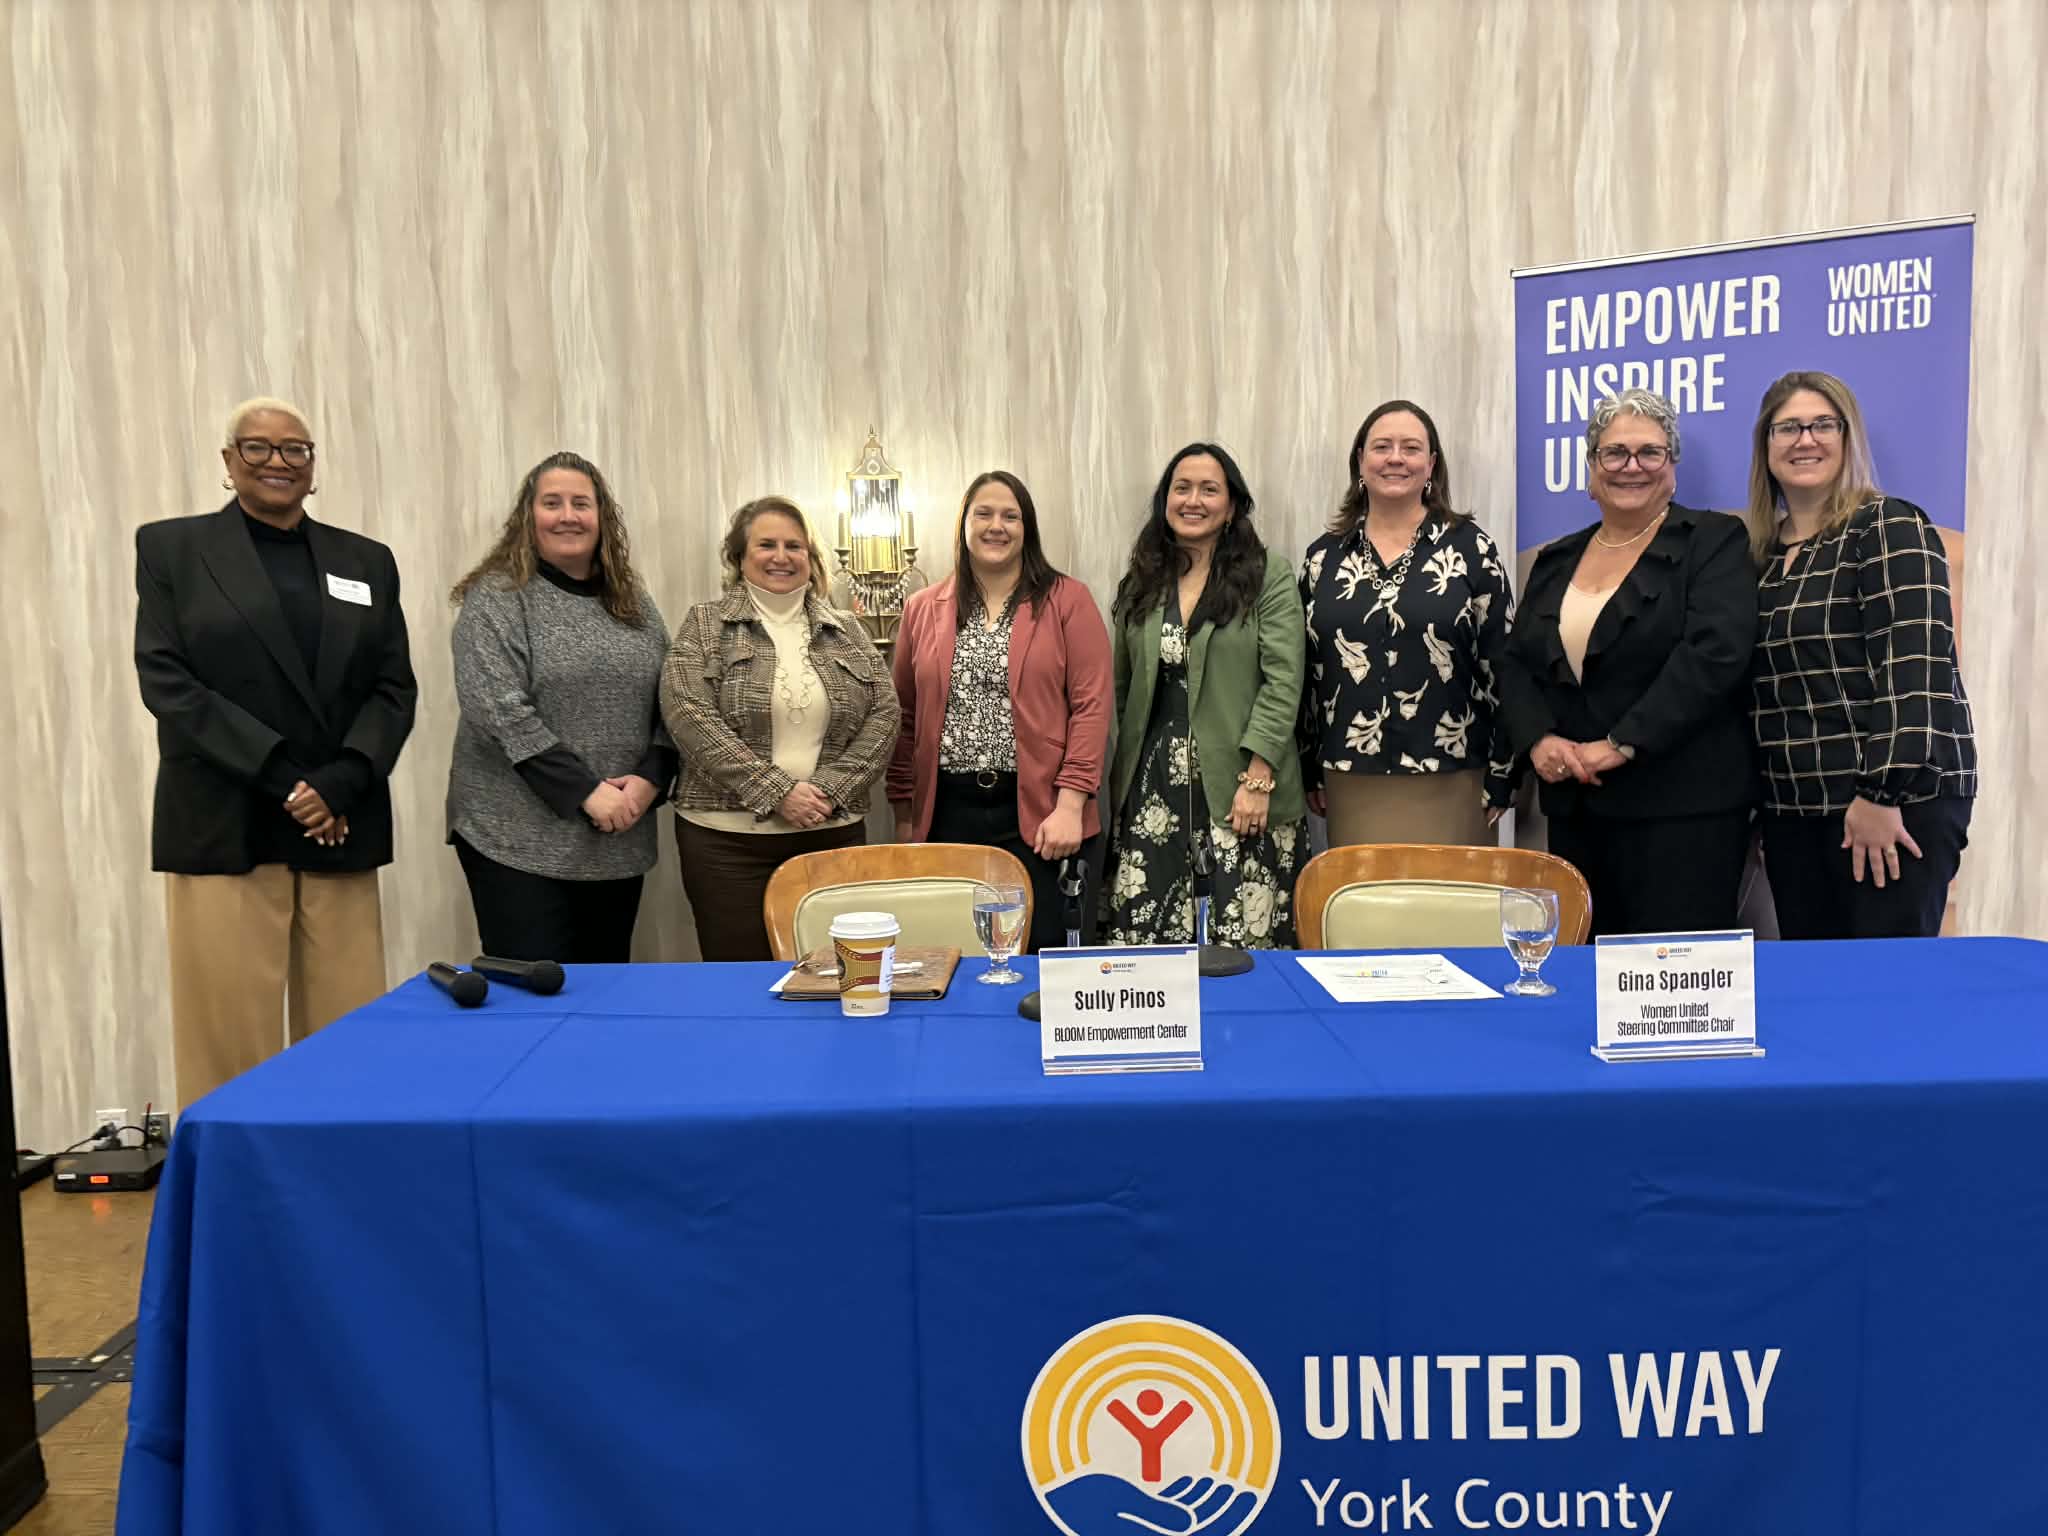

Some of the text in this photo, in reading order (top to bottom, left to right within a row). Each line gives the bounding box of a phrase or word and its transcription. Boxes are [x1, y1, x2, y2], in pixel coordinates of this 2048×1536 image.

[1828, 256, 1932, 300] WOMEN
[1545, 274, 1780, 355] EMPOWER
[1828, 294, 1932, 336] UNITED
[1618, 968, 1734, 993] Gina Spangler
[1074, 987, 1166, 1012] Sully Pinos
[1640, 1002, 1709, 1019] Women United
[1054, 1023, 1189, 1043] BLOOM Empowerment Center
[1617, 1016, 1736, 1037] Steering Committee Chair
[1304, 1347, 1781, 1441] UNITED WAY
[1301, 1478, 1674, 1536] York County
